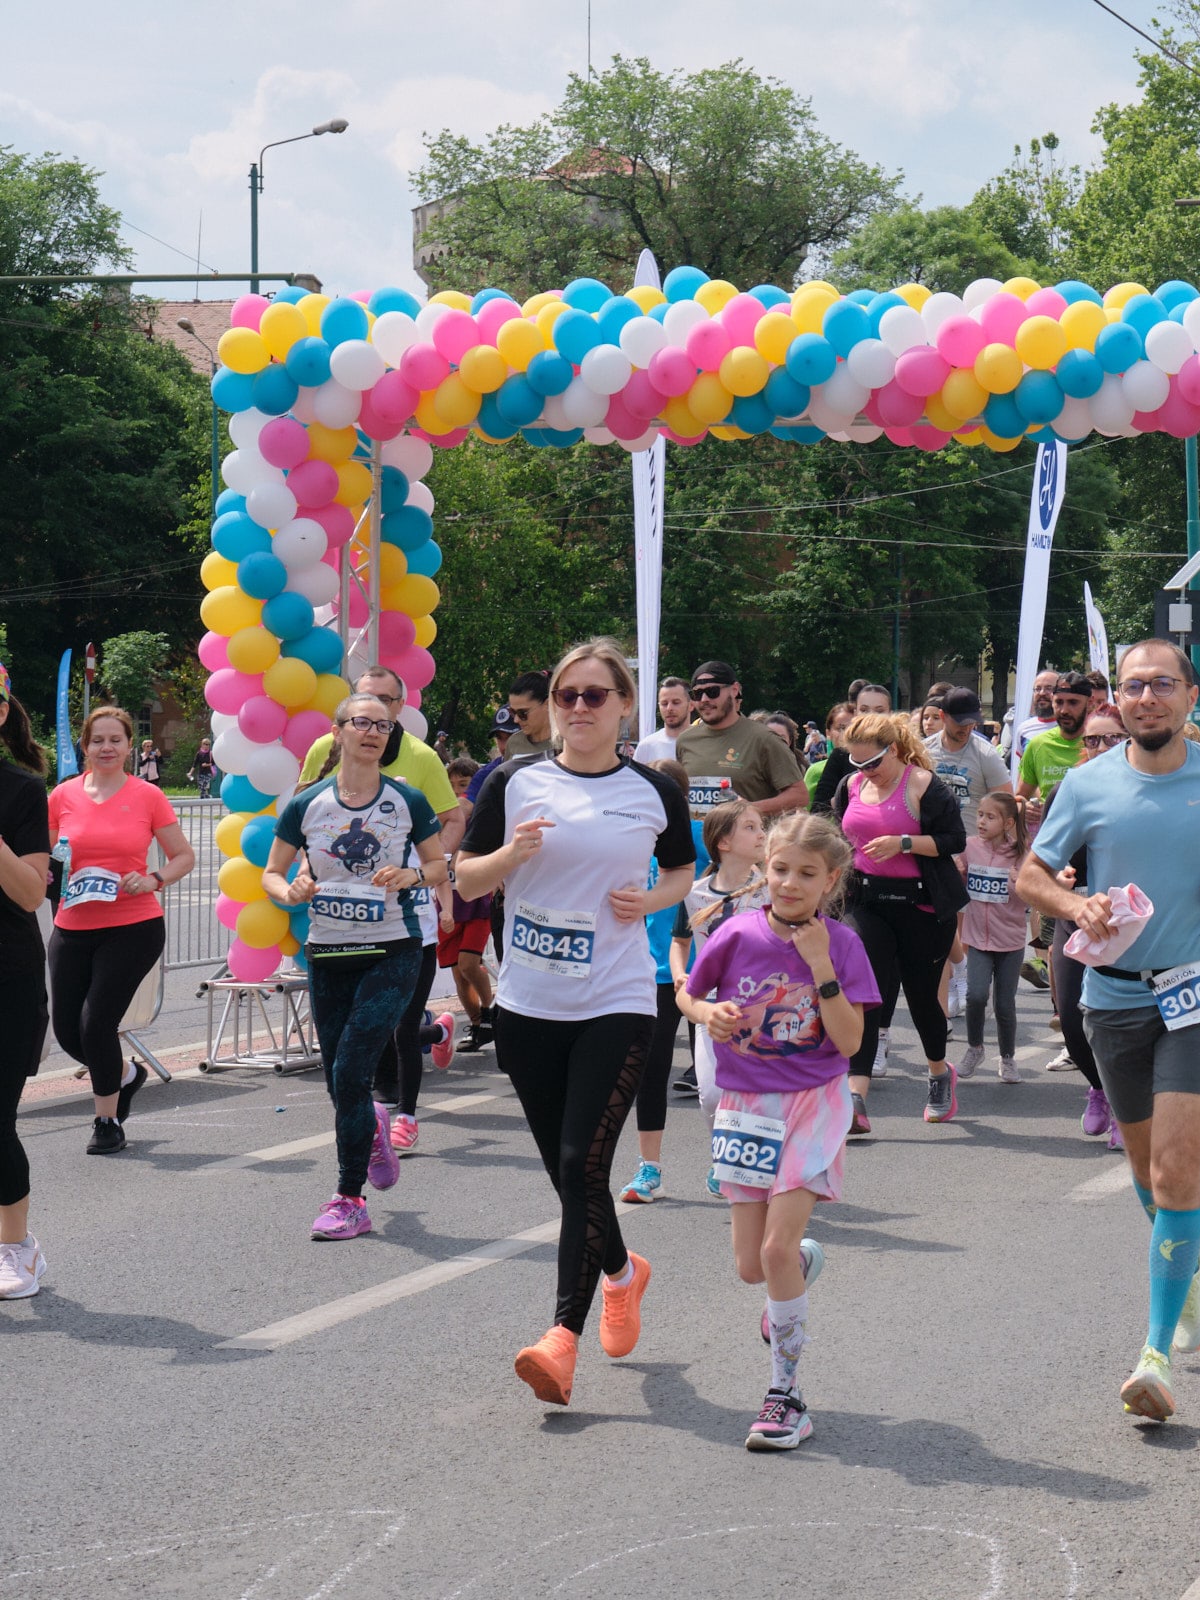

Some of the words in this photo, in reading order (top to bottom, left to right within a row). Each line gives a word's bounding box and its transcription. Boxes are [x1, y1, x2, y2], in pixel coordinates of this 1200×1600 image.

[688, 790, 721, 803] 3049
[603, 809, 637, 820] Continental
[69, 879, 118, 899] 30713
[968, 877, 1009, 894] 30395
[316, 900, 380, 921] 30861
[514, 923, 591, 960] 30843
